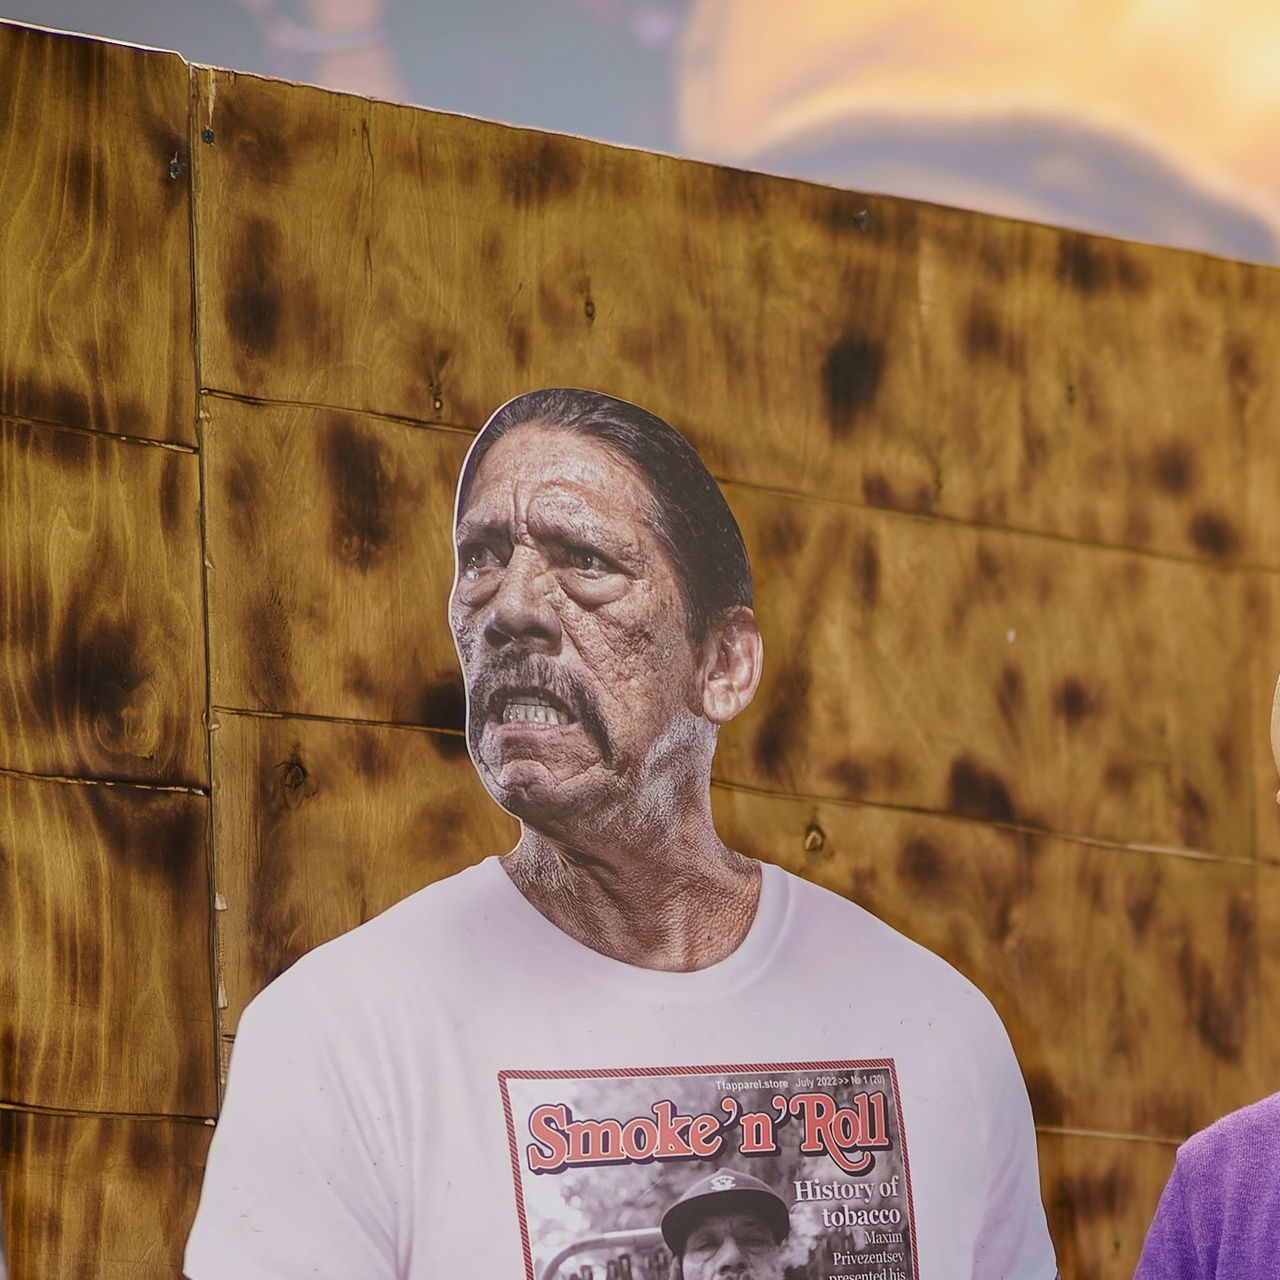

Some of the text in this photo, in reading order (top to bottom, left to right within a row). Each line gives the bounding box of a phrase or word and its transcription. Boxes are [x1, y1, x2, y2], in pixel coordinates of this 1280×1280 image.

[796, 1078, 814, 1088] July
[870, 1074, 886, 1084] (20)
[793, 1175, 899, 1203] History of
[822, 1204, 900, 1226] tobacco
[864, 1230, 902, 1244] Maxim
[833, 1251, 904, 1266] Privezentsev
